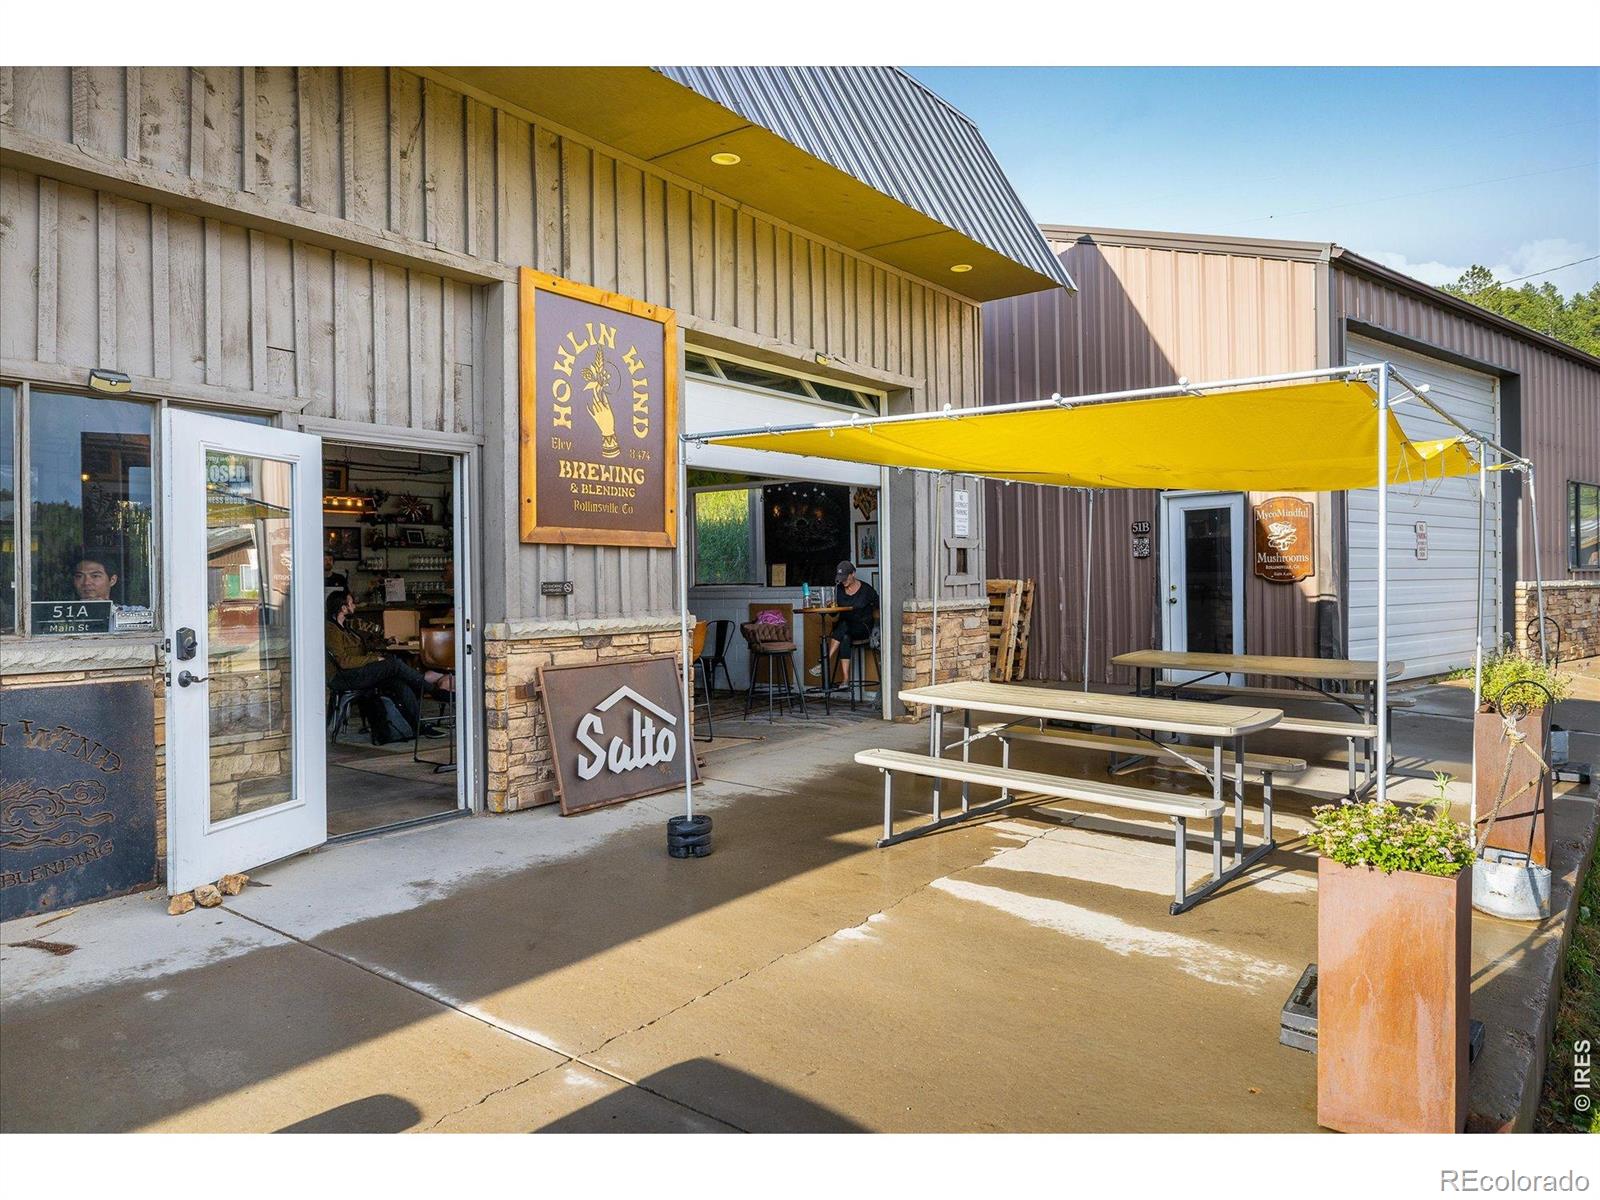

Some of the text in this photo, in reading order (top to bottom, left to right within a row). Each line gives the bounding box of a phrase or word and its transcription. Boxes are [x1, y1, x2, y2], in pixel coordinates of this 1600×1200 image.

[552, 322, 650, 439] HOWLIN WIND
[558, 459, 645, 485] BREWING
[570, 482, 636, 498] & BLENDING
[573, 500, 633, 514] Rollinsville Co
[1256, 508, 1309, 520] MycoMindful
[1132, 522, 1150, 532] 51B
[1257, 552, 1310, 563] Mushrooms
[52, 605, 89, 618] 51A
[49, 623, 89, 632] Main St
[18, 719, 122, 773] WIND
[576, 708, 677, 781] Salto
[0, 838, 114, 889] BLENDING
